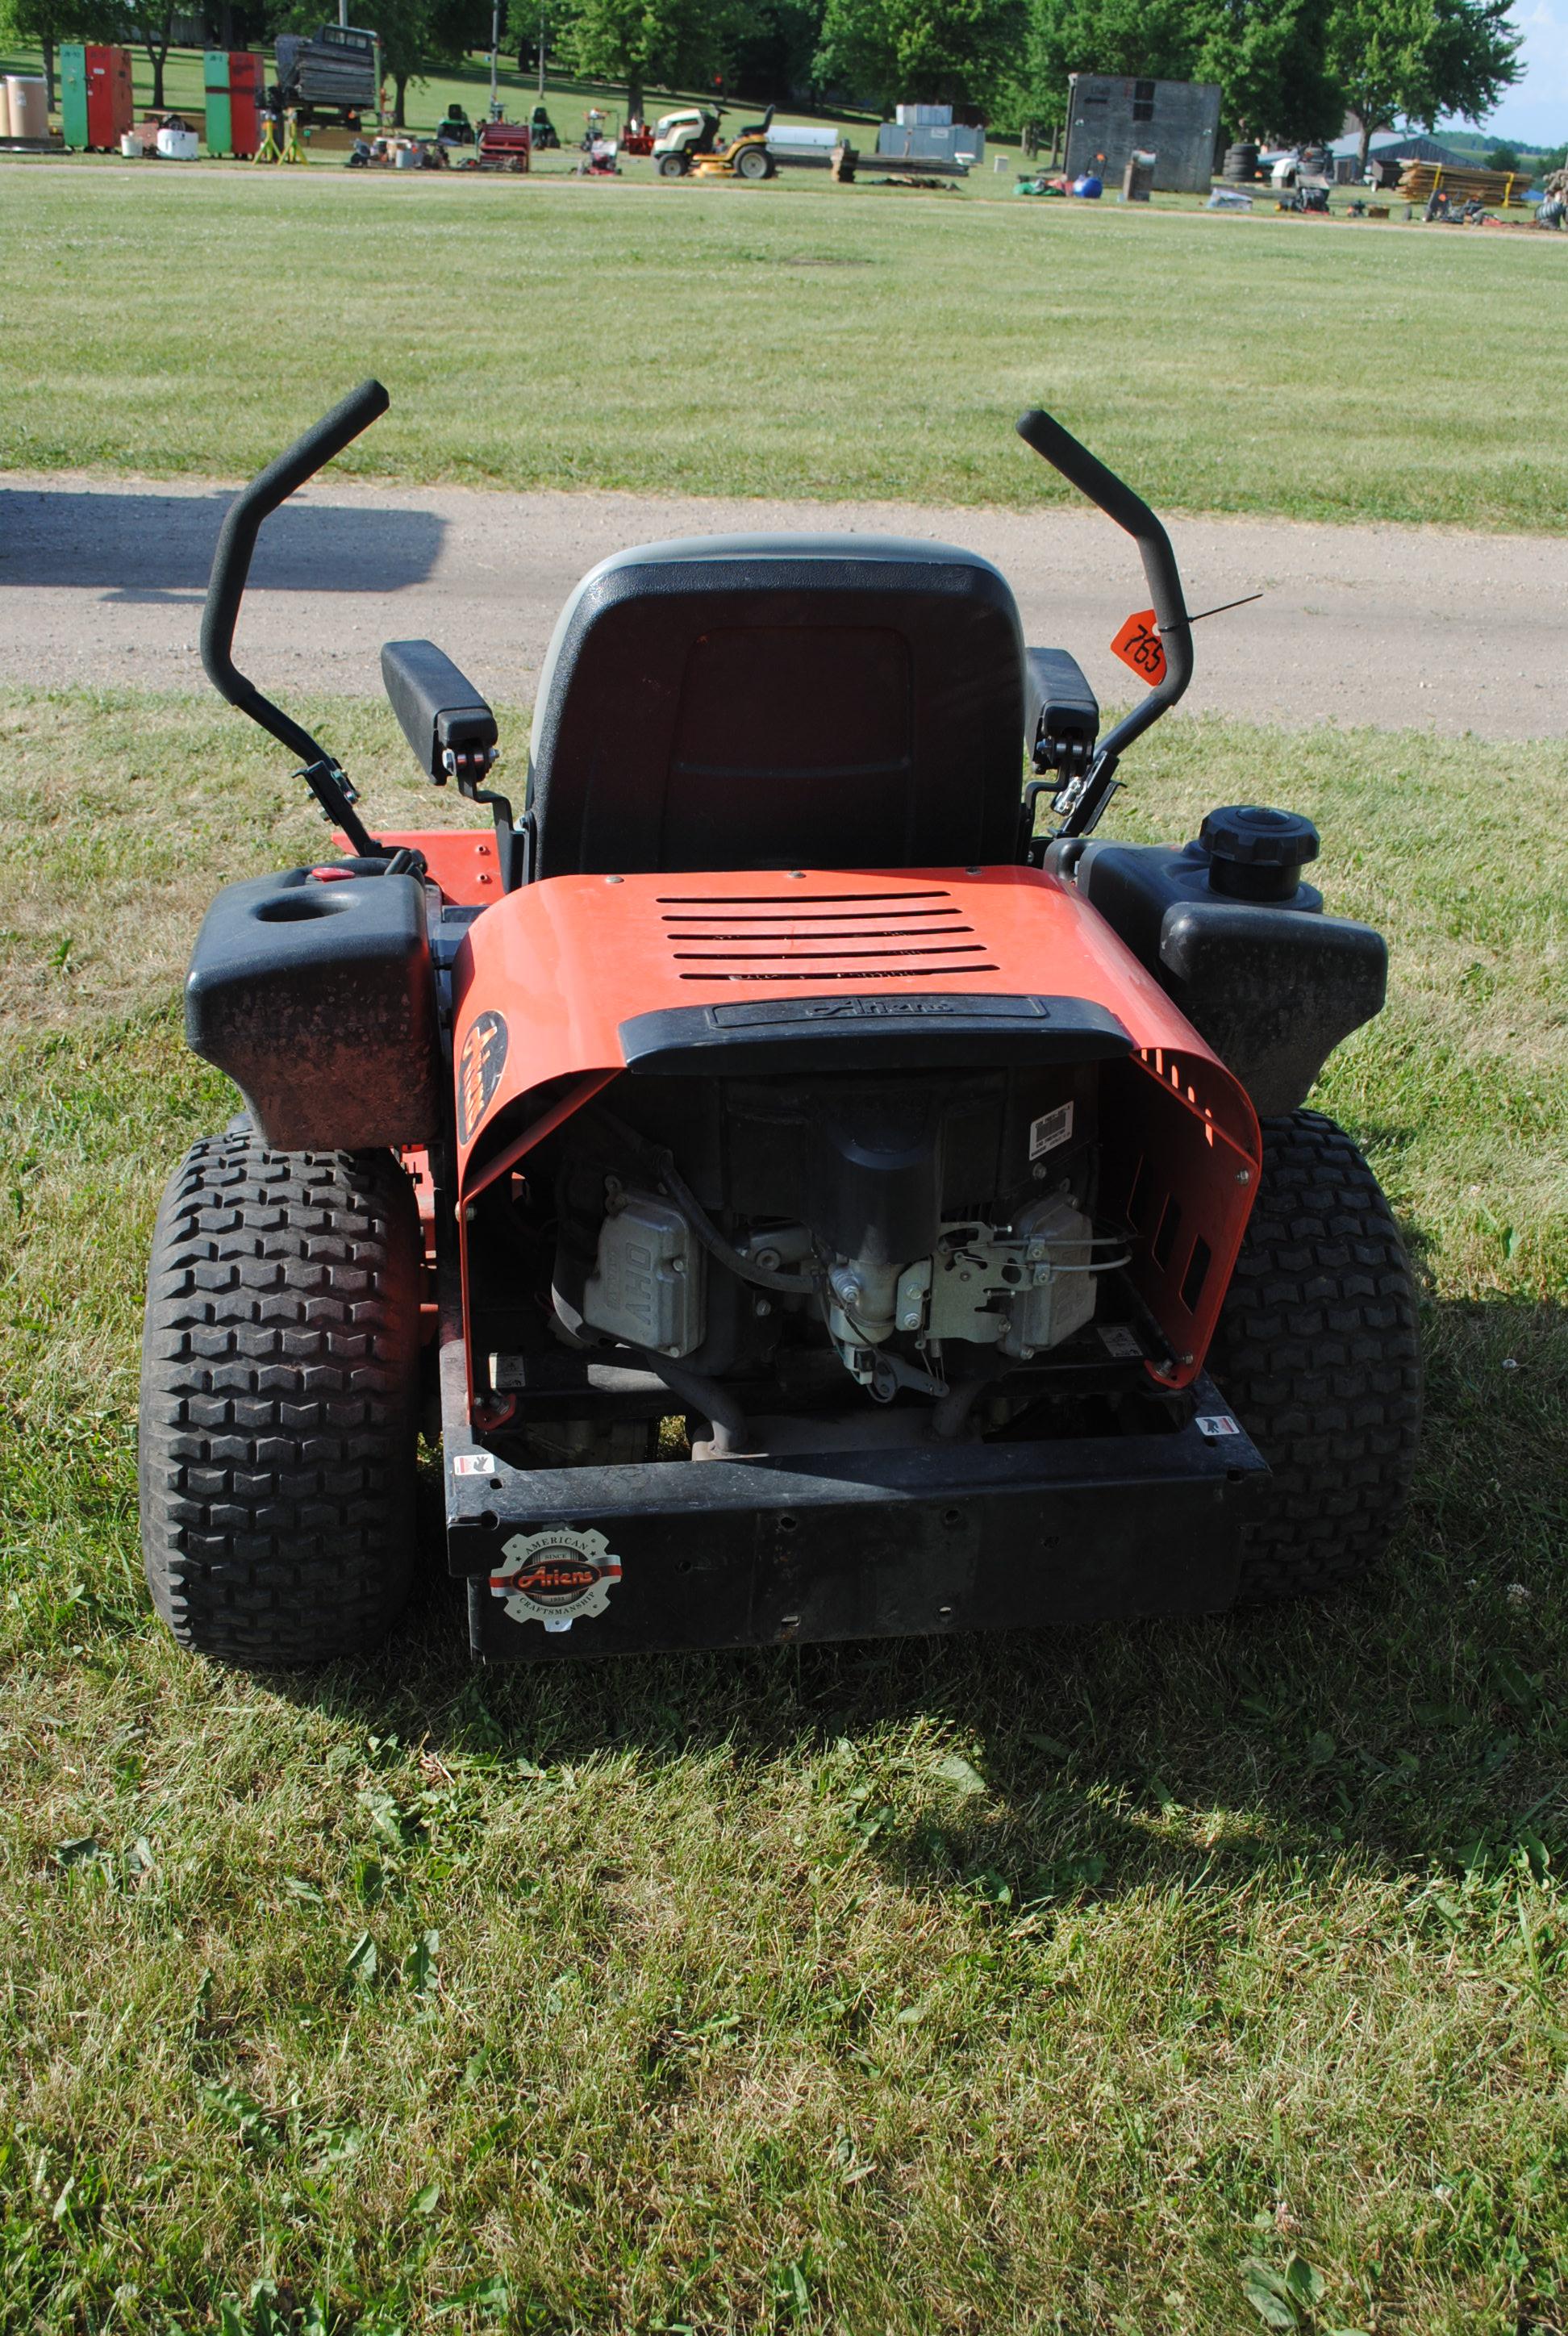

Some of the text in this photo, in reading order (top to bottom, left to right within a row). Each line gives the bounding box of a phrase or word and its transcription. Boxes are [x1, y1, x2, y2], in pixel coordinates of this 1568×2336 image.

[1124, 624, 1164, 674] 765
[525, 1536, 589, 1555] AMERICAN
[517, 1566, 594, 1588] Ariens
[519, 1591, 595, 1616] CRAFTSMANSHIP
